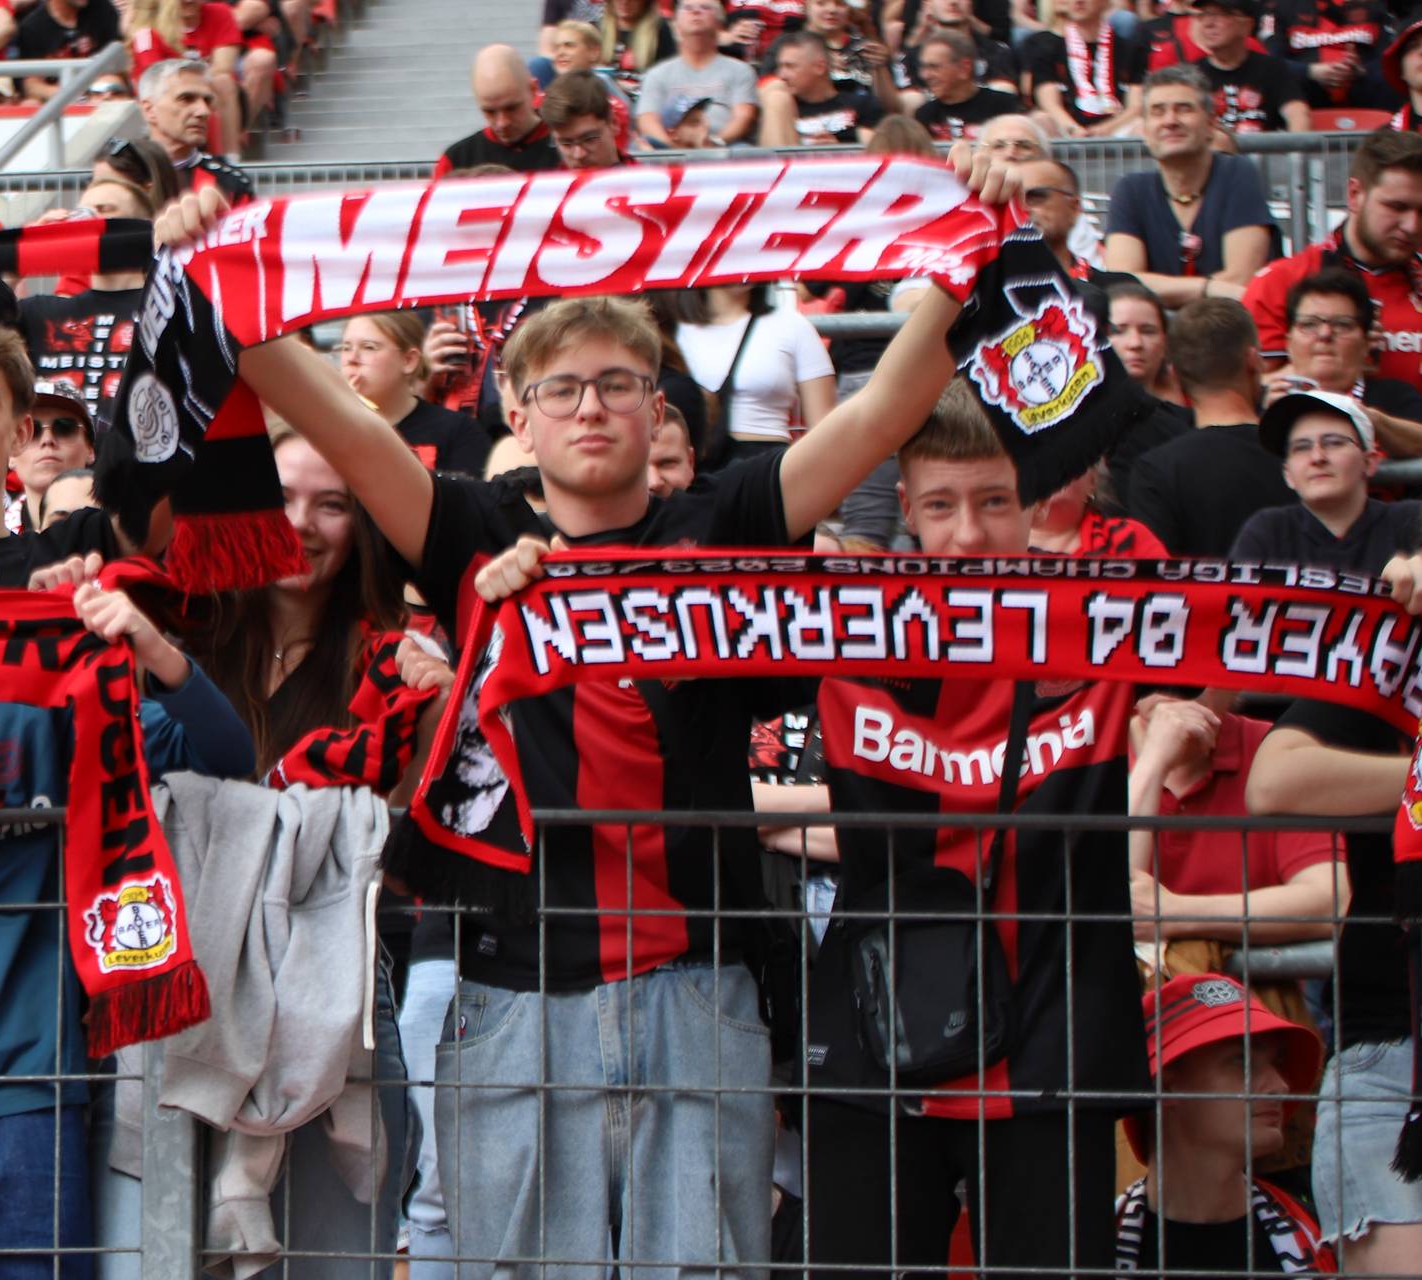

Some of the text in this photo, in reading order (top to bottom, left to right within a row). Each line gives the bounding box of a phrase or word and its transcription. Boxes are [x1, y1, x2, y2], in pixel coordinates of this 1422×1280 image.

[280, 157, 970, 324] MEISTER
[39, 353, 128, 369] MEIST
[520, 587, 1422, 719] AYER 04 LEVERKUSEN
